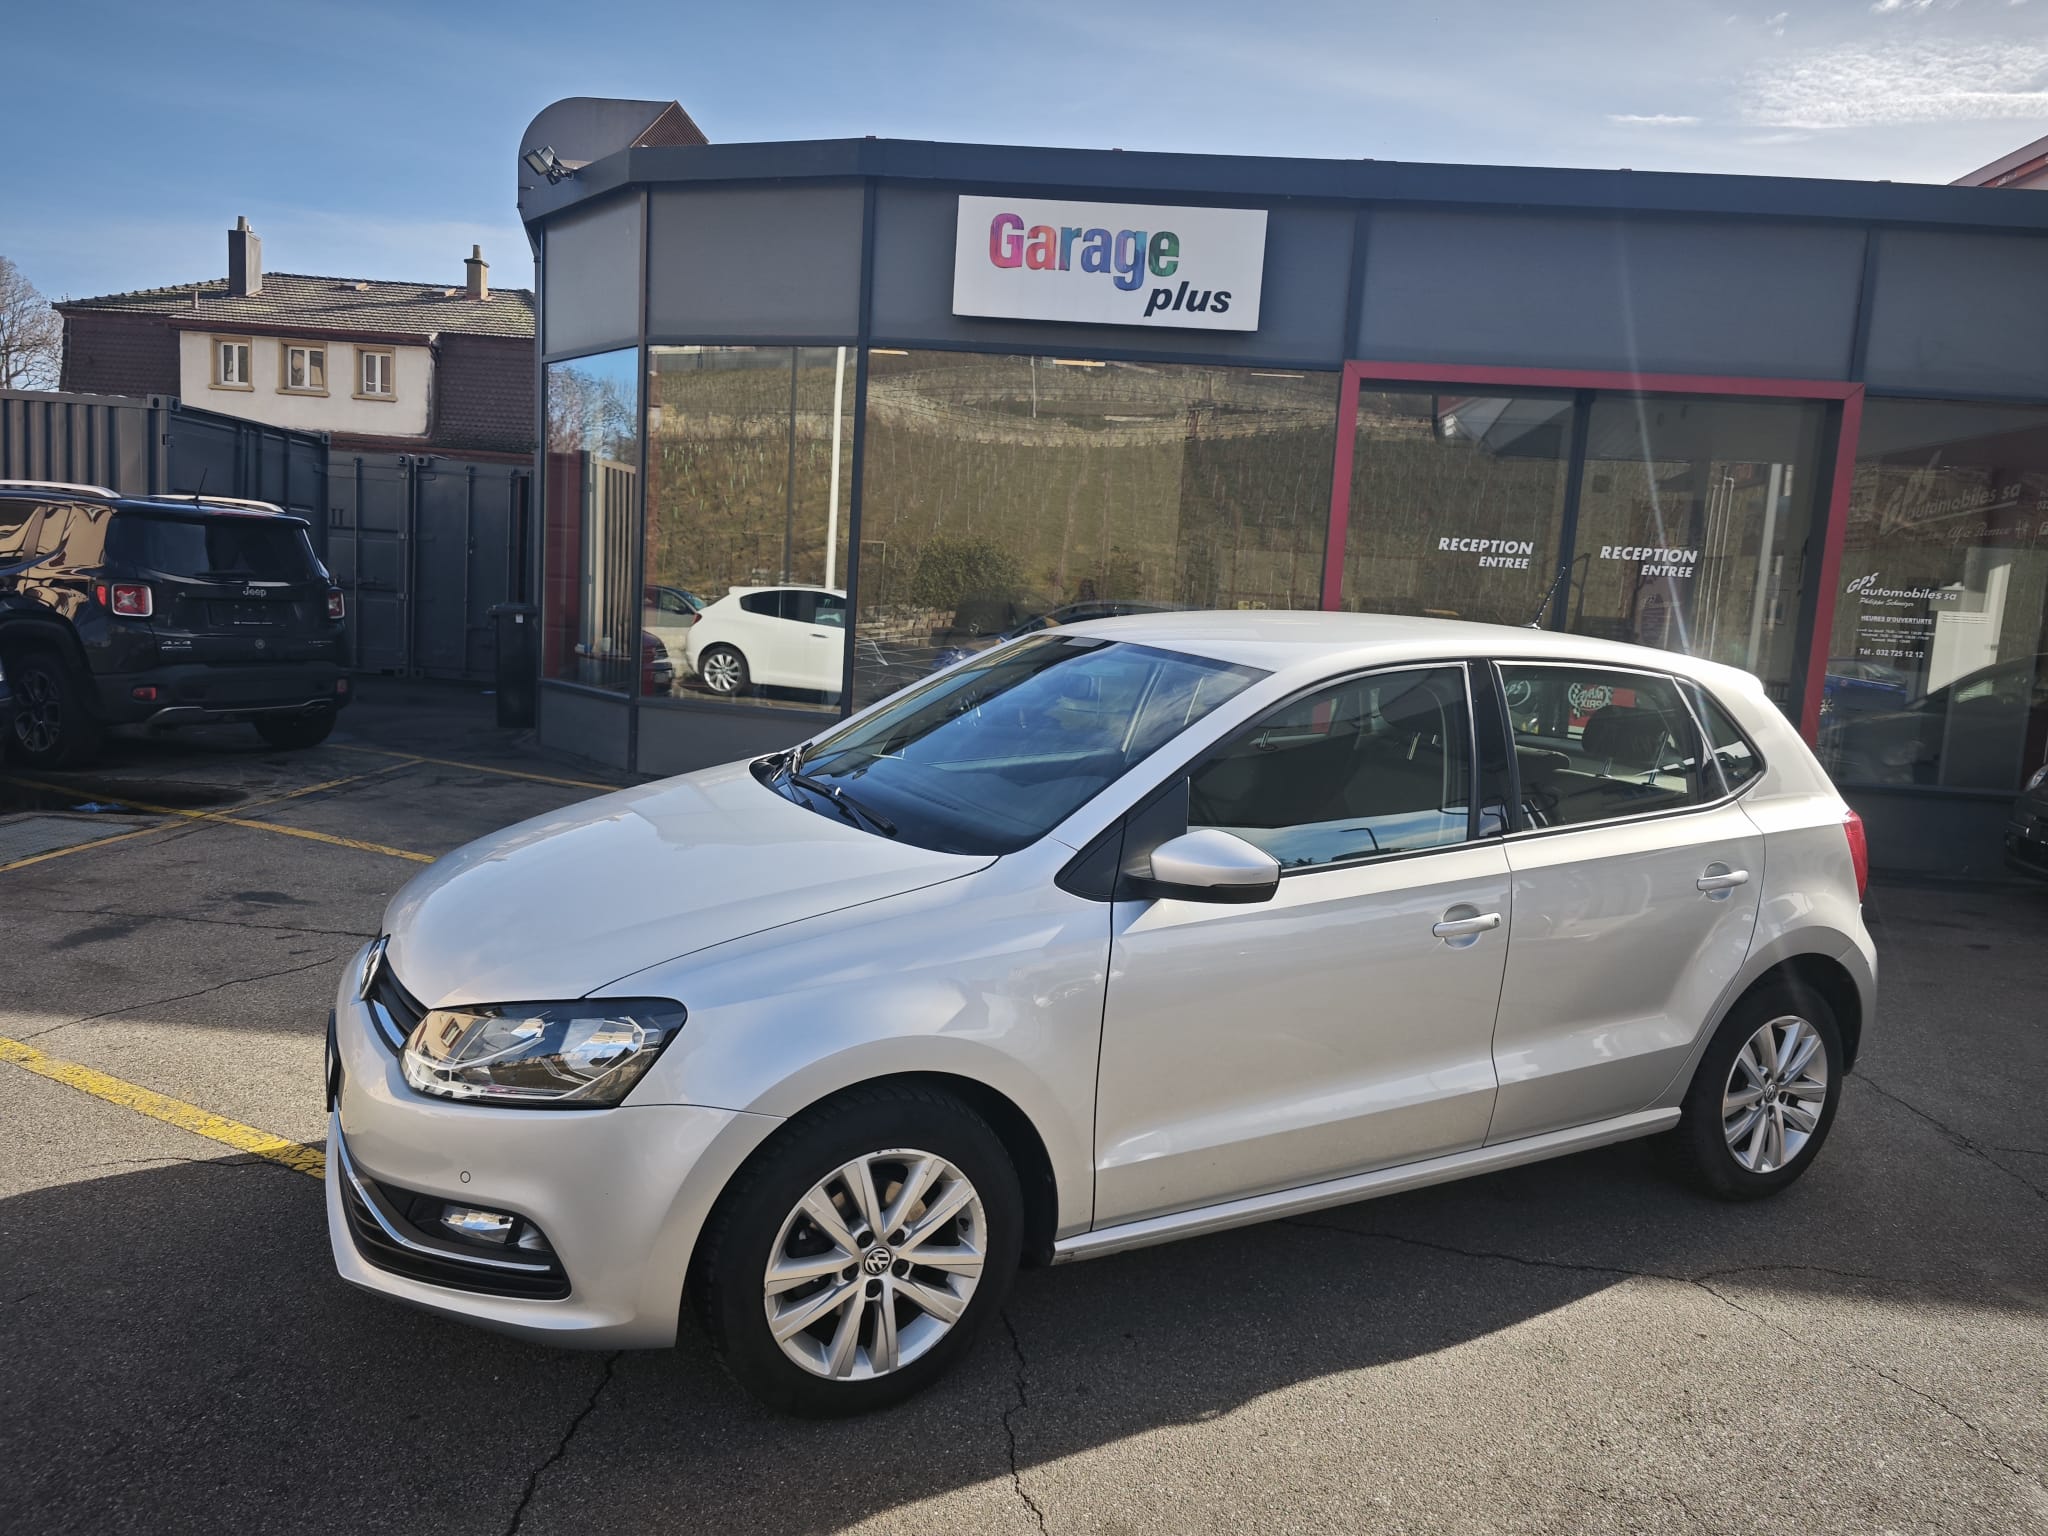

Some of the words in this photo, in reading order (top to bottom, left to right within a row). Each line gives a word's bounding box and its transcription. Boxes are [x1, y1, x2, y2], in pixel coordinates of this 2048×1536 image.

[989, 212, 1180, 291] Garage
[1144, 281, 1232, 317] plus
[1438, 537, 1534, 555] RECEPTION
[1478, 556, 1530, 569] ENTREE
[1600, 545, 1698, 564] RECEPTION
[1641, 564, 1693, 578] ENTREE
[1846, 572, 1879, 593] GPS
[242, 586, 267, 598] Jeep
[1860, 588, 1942, 600] automobiles
[1943, 592, 1957, 601] sa
[1876, 649, 1890, 657] 032
[1891, 650, 1904, 658] 725
[1905, 650, 1914, 658] 12
[1915, 651, 1924, 659] 12
